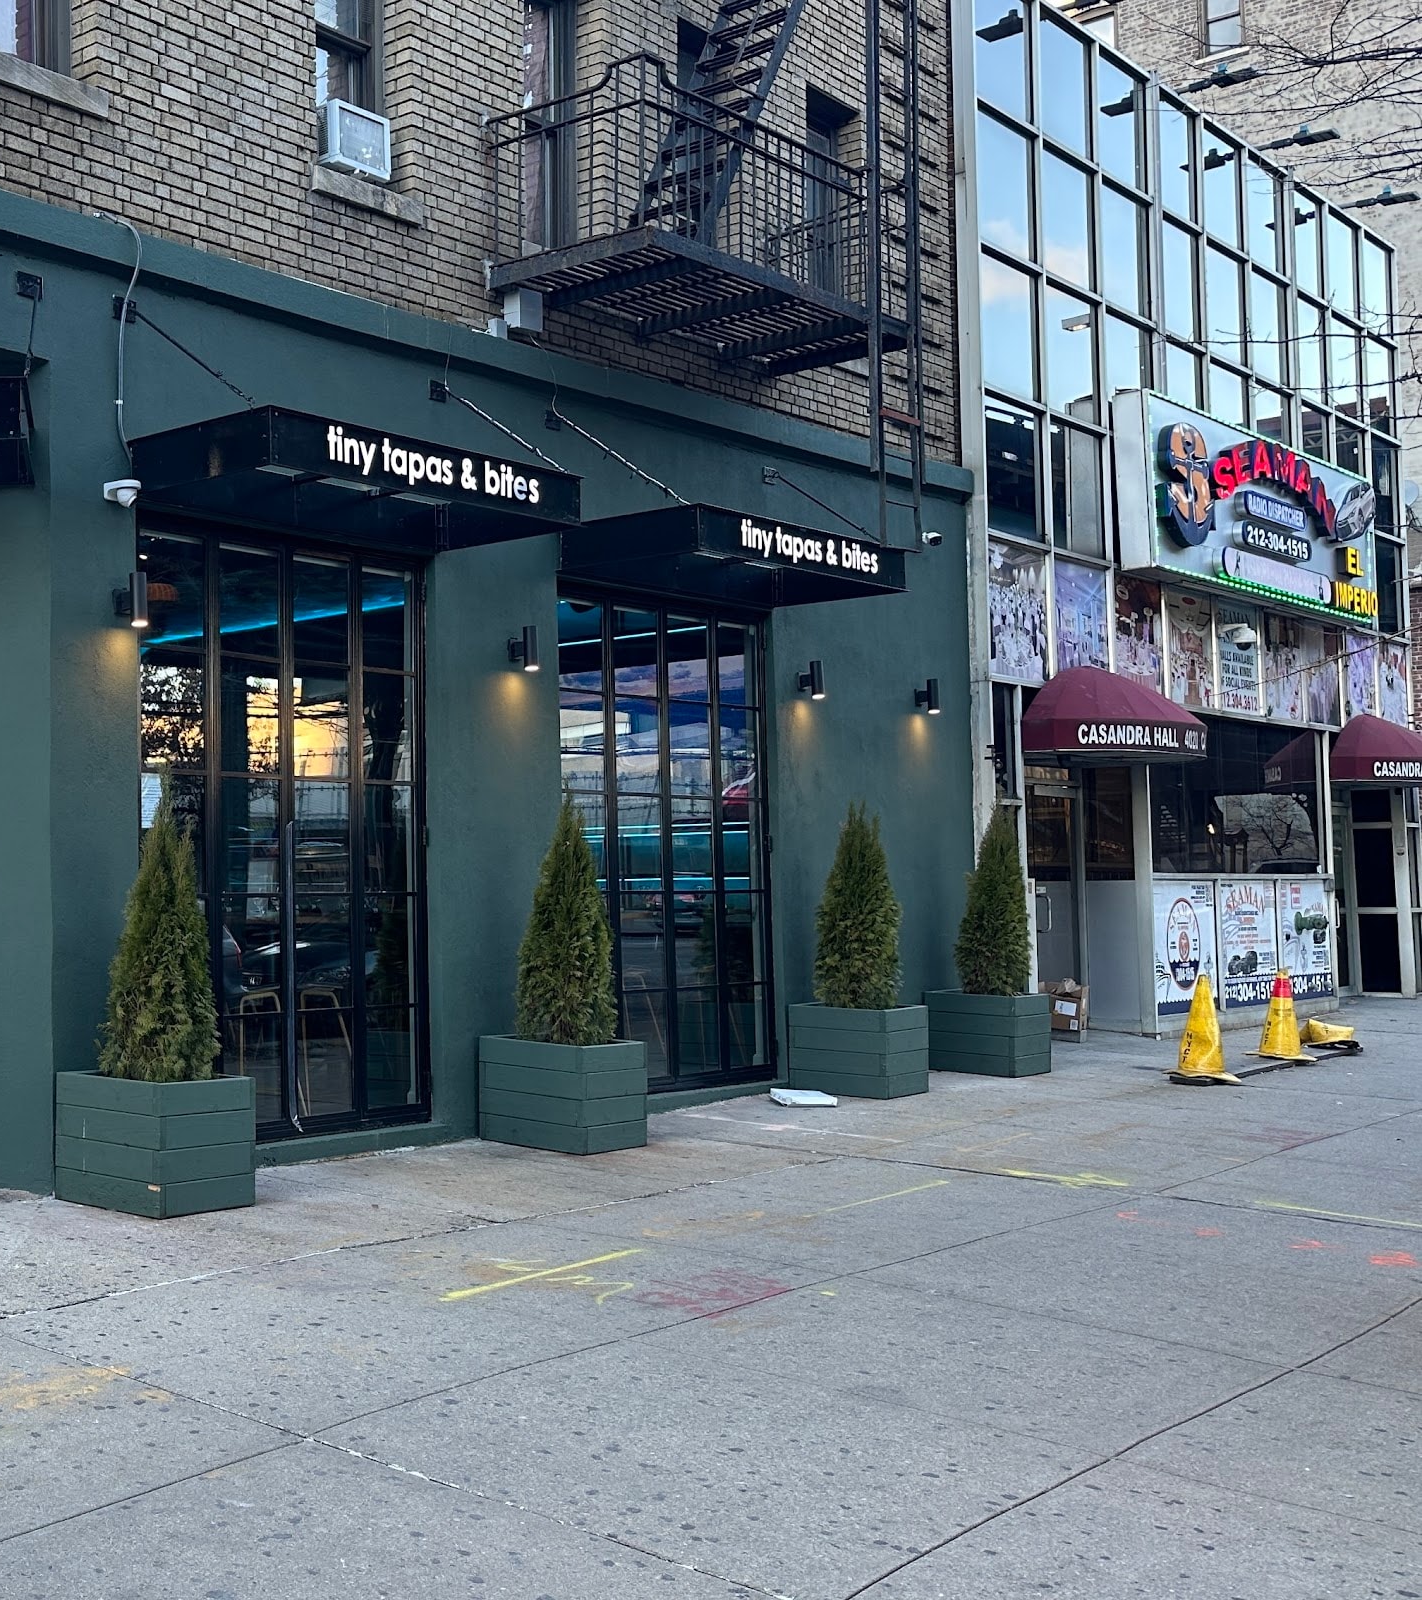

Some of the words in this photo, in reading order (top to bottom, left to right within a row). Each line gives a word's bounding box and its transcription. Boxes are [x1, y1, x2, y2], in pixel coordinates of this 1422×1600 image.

[327, 425, 376, 475] tiny
[382, 438, 453, 485] tapas
[461, 458, 477, 490] &
[484, 461, 540, 503] bites
[1212, 439, 1335, 537] SEAMAN
[1248, 493, 1267, 516] RADIO
[1268, 501, 1305, 527] DISPATCHER
[741, 519, 773, 558] tiny
[775, 526, 823, 563] tapas
[826, 539, 838, 565] &
[842, 540, 878, 574] bites
[1247, 525, 1309, 560] 212-304-1515
[1347, 547, 1364, 577] EL
[1335, 581, 1378, 617] IMPERIO
[1078, 723, 1151, 746] CASANDRA
[1154, 726, 1179, 748] HALL
[1373, 761, 1422, 778] CASANDR
[1182, 1032, 1193, 1064] NYCT
